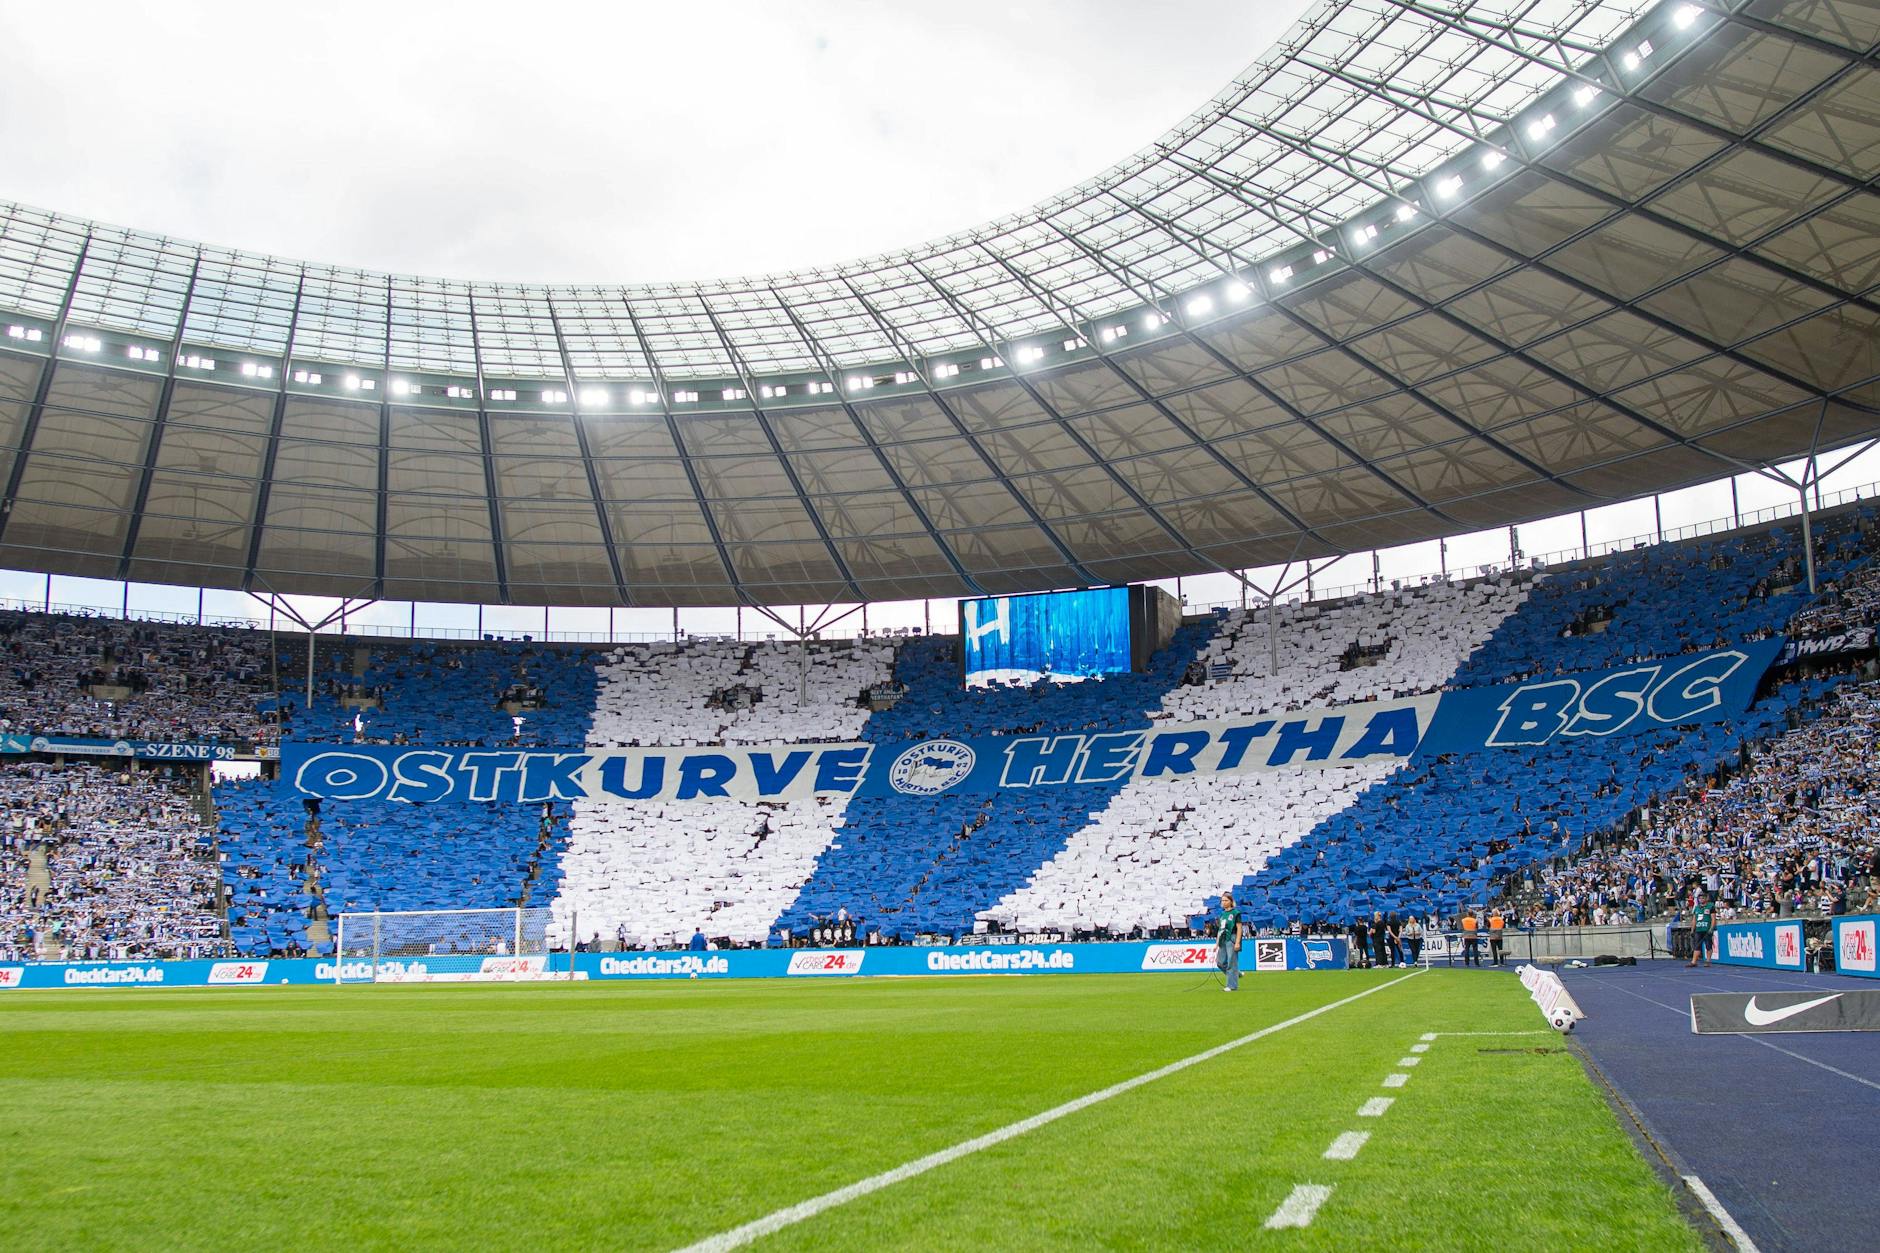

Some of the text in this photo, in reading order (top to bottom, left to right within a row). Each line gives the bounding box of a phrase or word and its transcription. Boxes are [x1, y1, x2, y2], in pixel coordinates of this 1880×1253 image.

[295, 650, 1749, 803] OSTKURVE HERTHA BSC
[901, 744, 969, 766] OSTKURVE
[1855, 930, 1867, 961] 24
[600, 955, 729, 975] CheckCars24.de
[824, 955, 846, 969] 24
[927, 949, 1074, 970] CheckCars24.de
[1183, 948, 1208, 964] 24
[64, 966, 164, 984] CheckCars24.de
[236, 966, 253, 978] 24
[315, 961, 428, 980] CheckCas24.de
